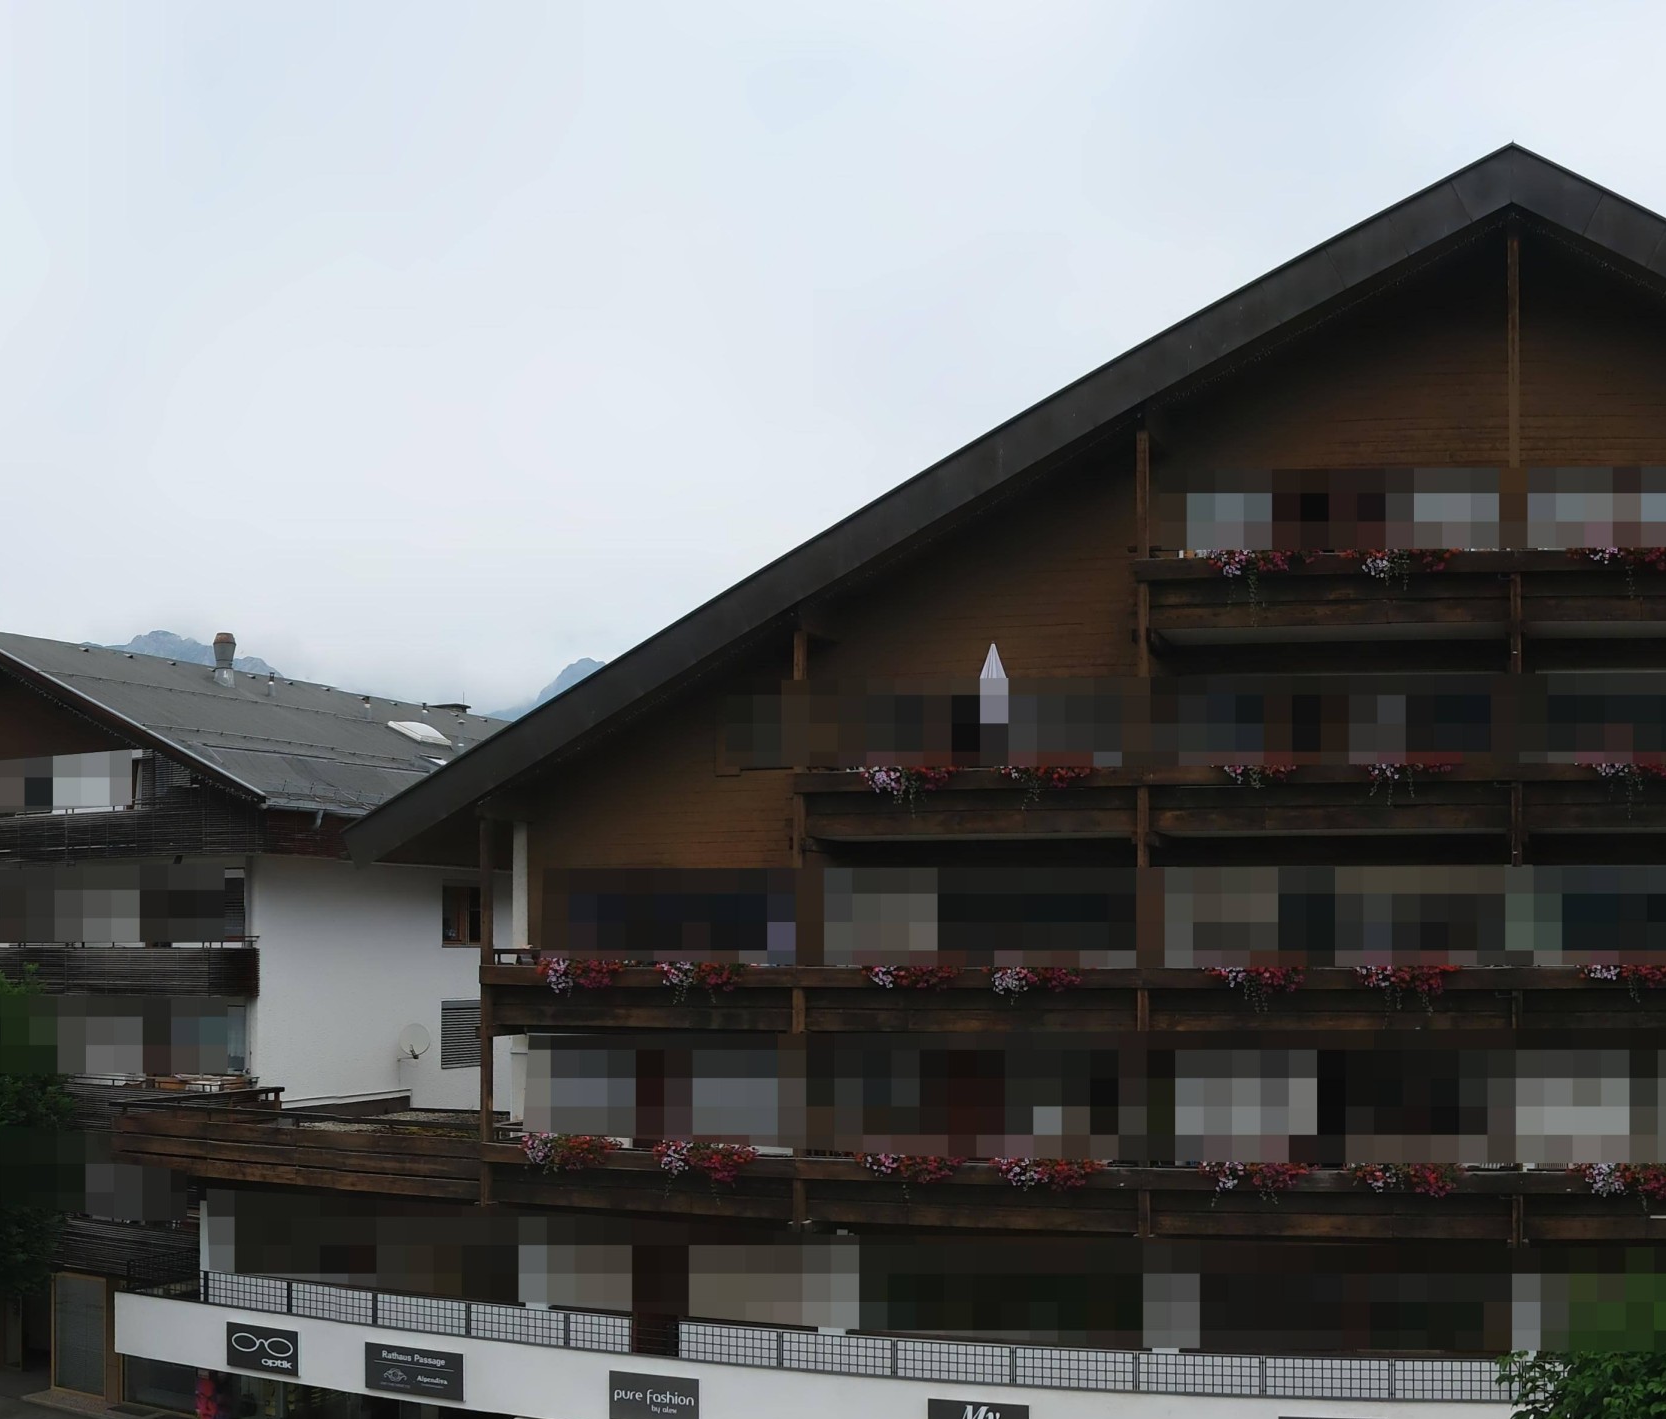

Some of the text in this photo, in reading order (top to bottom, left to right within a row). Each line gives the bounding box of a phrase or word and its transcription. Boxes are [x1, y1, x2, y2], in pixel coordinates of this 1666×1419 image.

[261, 1357, 293, 1370] optik
[382, 1350, 446, 1367] Rathaus Passage
[614, 1388, 695, 1406] pure fashion
[651, 1405, 677, 1414] by alex
